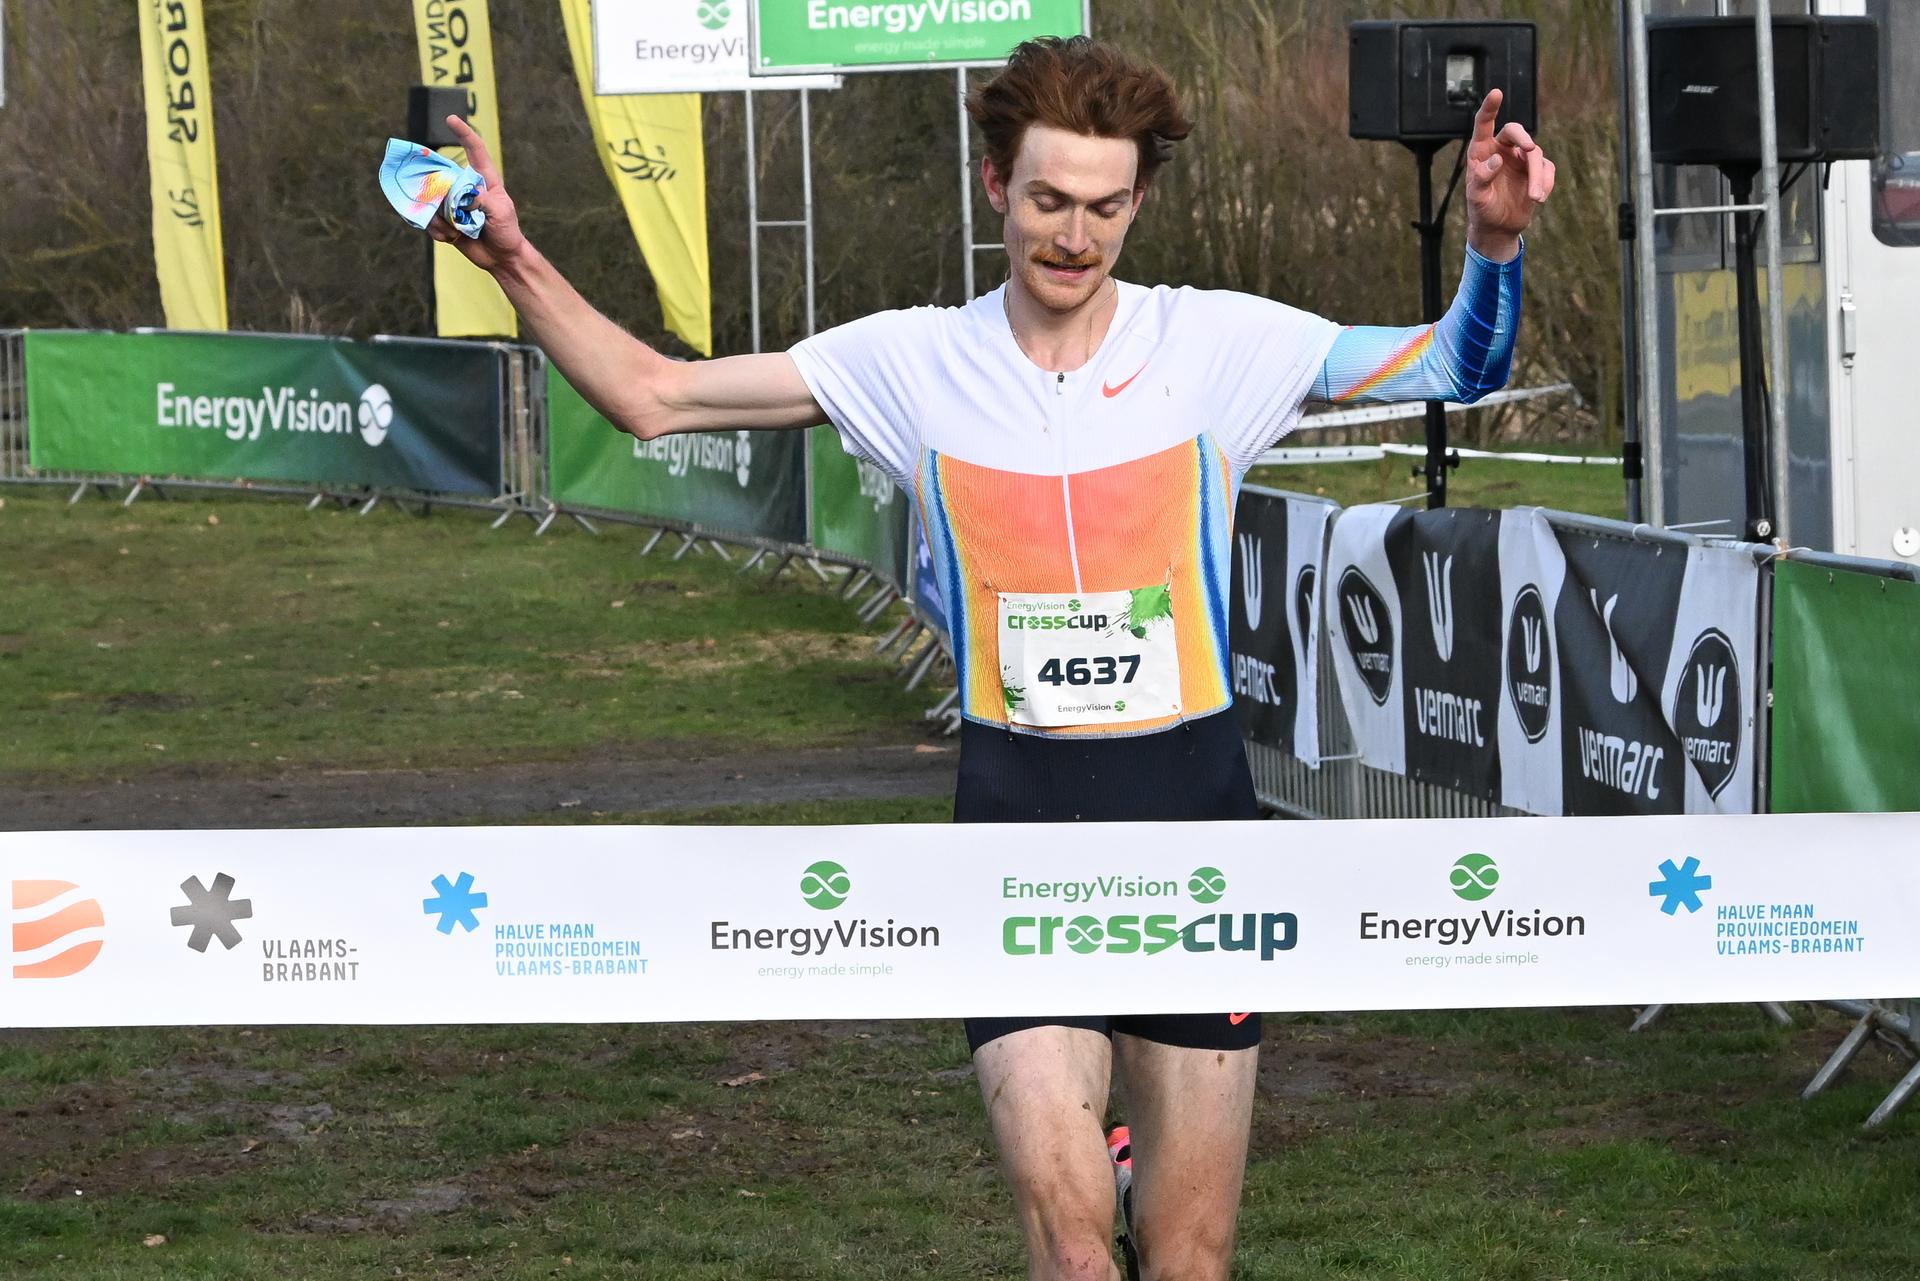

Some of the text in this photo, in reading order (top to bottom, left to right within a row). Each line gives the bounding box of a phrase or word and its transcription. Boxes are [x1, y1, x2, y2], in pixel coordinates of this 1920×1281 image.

[806, 0, 1032, 33] EnergyVision
[635, 37, 745, 64] EnergyVi
[156, 382, 353, 441] EnergyVision
[1007, 601, 1066, 613] EnergyVision
[1007, 613, 1108, 632] crosscup
[1037, 654, 1141, 687] 4637
[1057, 702, 1112, 714] EnergyVision
[1414, 686, 1484, 748] vermarc
[1578, 725, 1665, 800] vermarc
[1002, 876, 1179, 903] EnergyVision
[1717, 904, 1815, 920] HALVE MAAN
[494, 923, 595, 940] HALVE MAAN
[1003, 911, 1299, 962] crosscup
[1360, 908, 1586, 946] EnergyVision
[1717, 920, 1858, 937] PROVINCIEDOMEIN
[711, 918, 940, 957] EnergyVision
[1717, 937, 1864, 955] VLAAMS-BRABANT
[263, 939, 358, 959] VLAAMS-
[495, 941, 642, 958] PROVINCIEDOMEIN
[495, 959, 649, 976] VLAAMS-BRABANT
[1405, 951, 1539, 969] energy made simple
[263, 961, 360, 982] BRABANT
[758, 962, 894, 979] energy made simple
